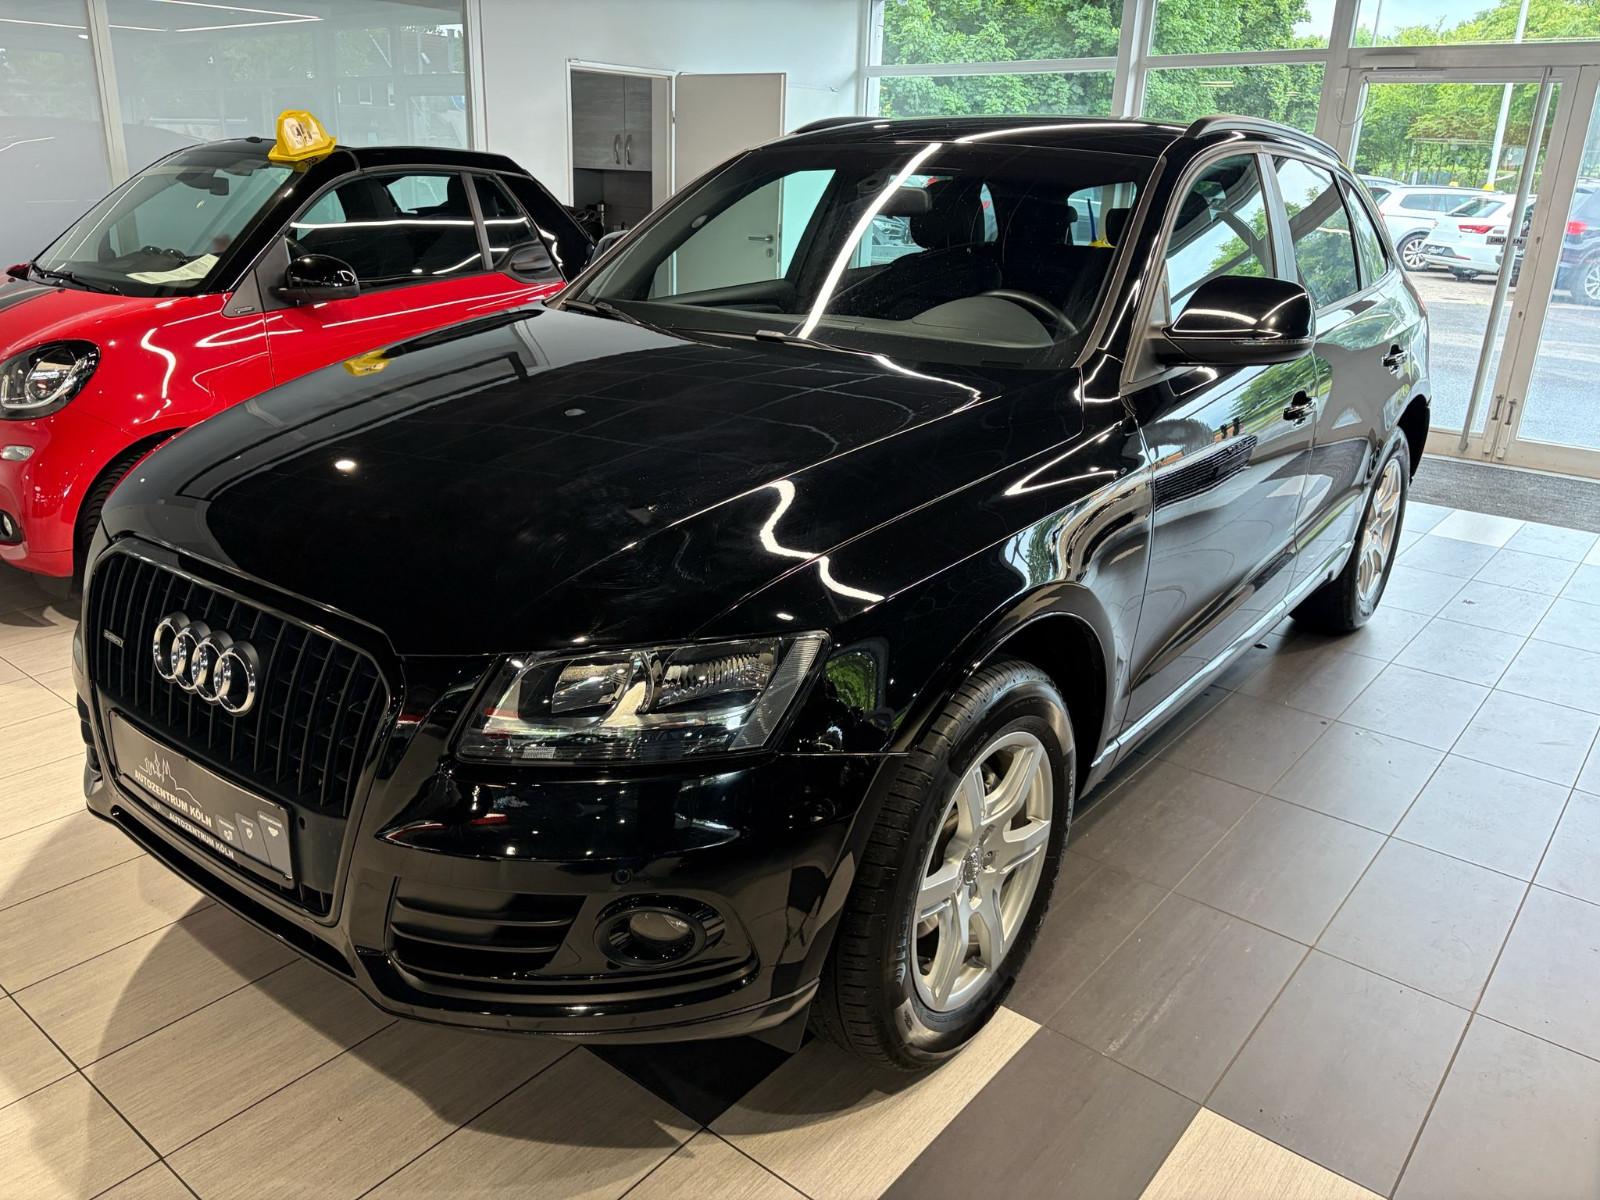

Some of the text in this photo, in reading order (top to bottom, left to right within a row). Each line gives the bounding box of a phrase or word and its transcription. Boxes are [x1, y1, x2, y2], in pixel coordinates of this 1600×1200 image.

[135, 770, 212, 828] AUTOZENTRUM KÖLN
[169, 812, 215, 847] AUTOZENTRUM
[215, 841, 234, 859] KÖLN
